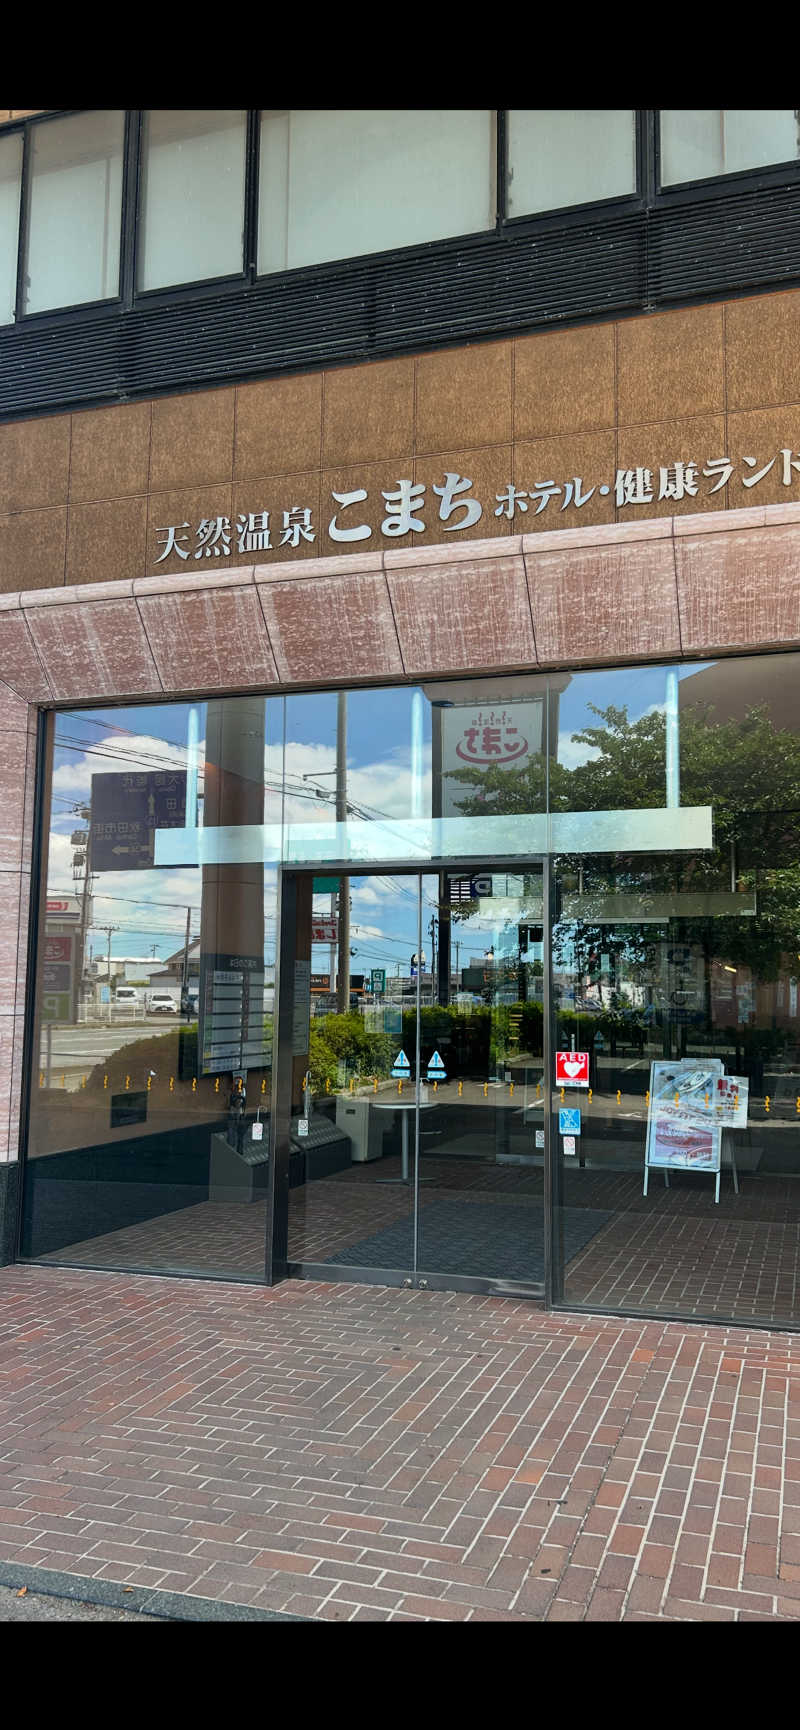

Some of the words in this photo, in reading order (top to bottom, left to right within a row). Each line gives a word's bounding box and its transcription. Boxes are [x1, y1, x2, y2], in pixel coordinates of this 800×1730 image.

[153, 507, 317, 565] 天然温泉
[328, 472, 483, 542] こまち
[559, 1053, 586, 1062] AED
